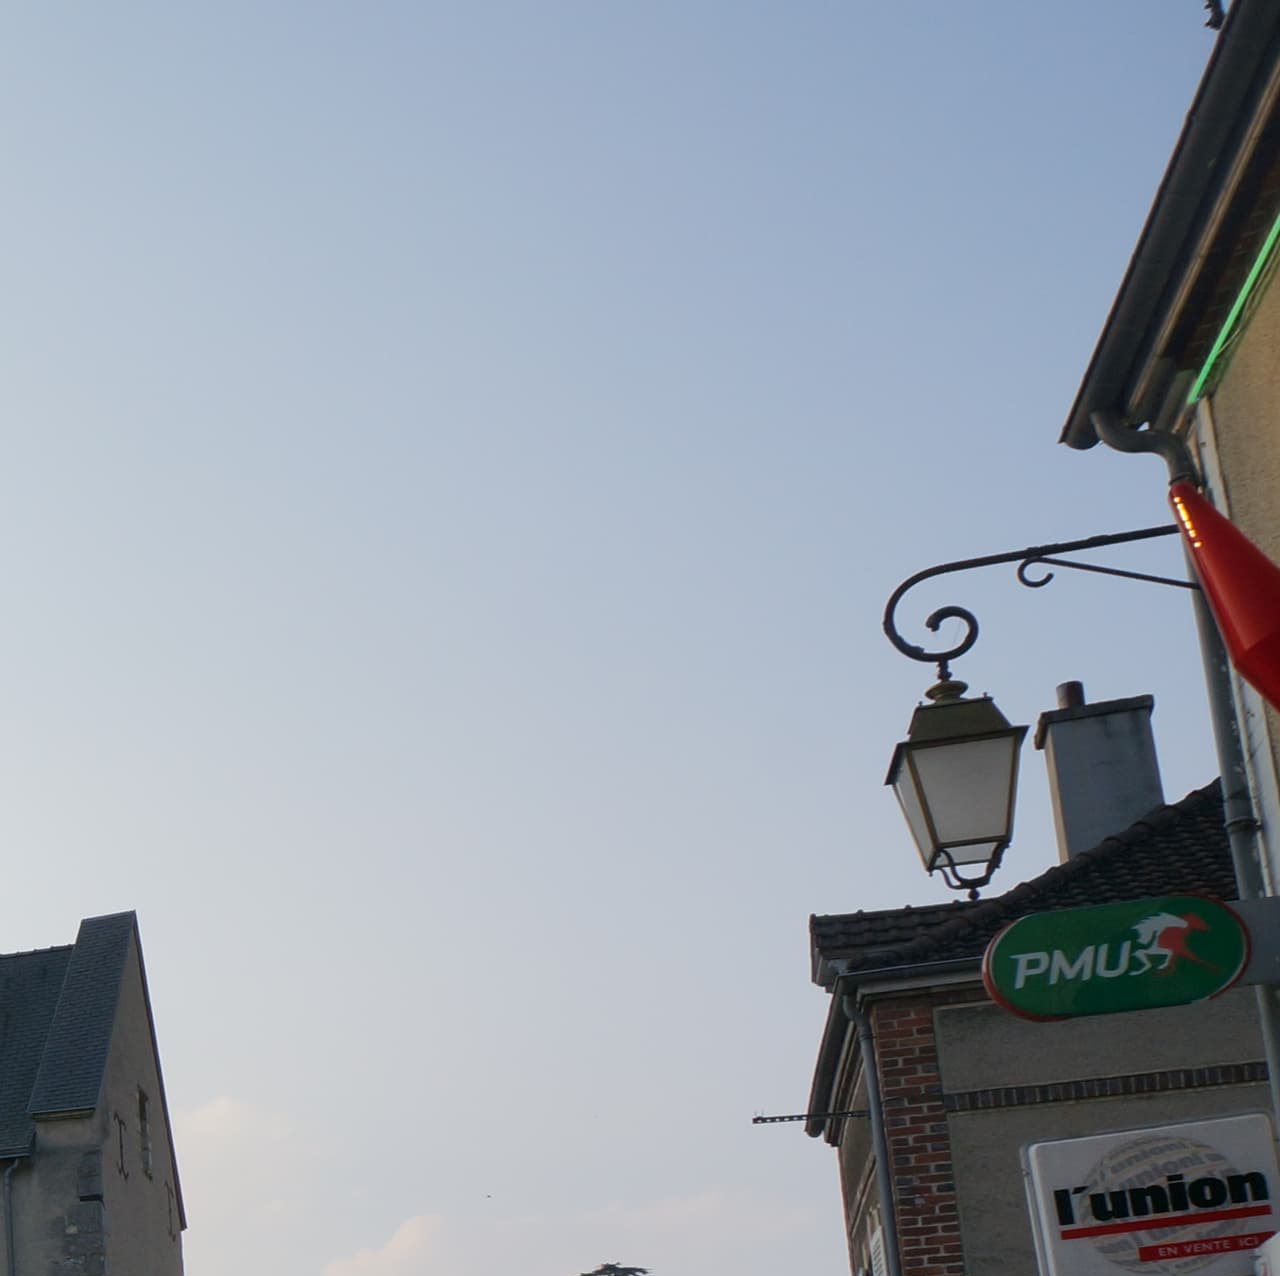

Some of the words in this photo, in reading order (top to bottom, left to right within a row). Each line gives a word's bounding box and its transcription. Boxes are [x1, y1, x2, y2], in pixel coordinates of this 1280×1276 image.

[1009, 940, 1131, 990] PMU
[1053, 1171, 1270, 1226] l'union
[1158, 1245, 1178, 1257] EN
[1183, 1239, 1232, 1254] VENTE
[1239, 1235, 1259, 1248] ICI
